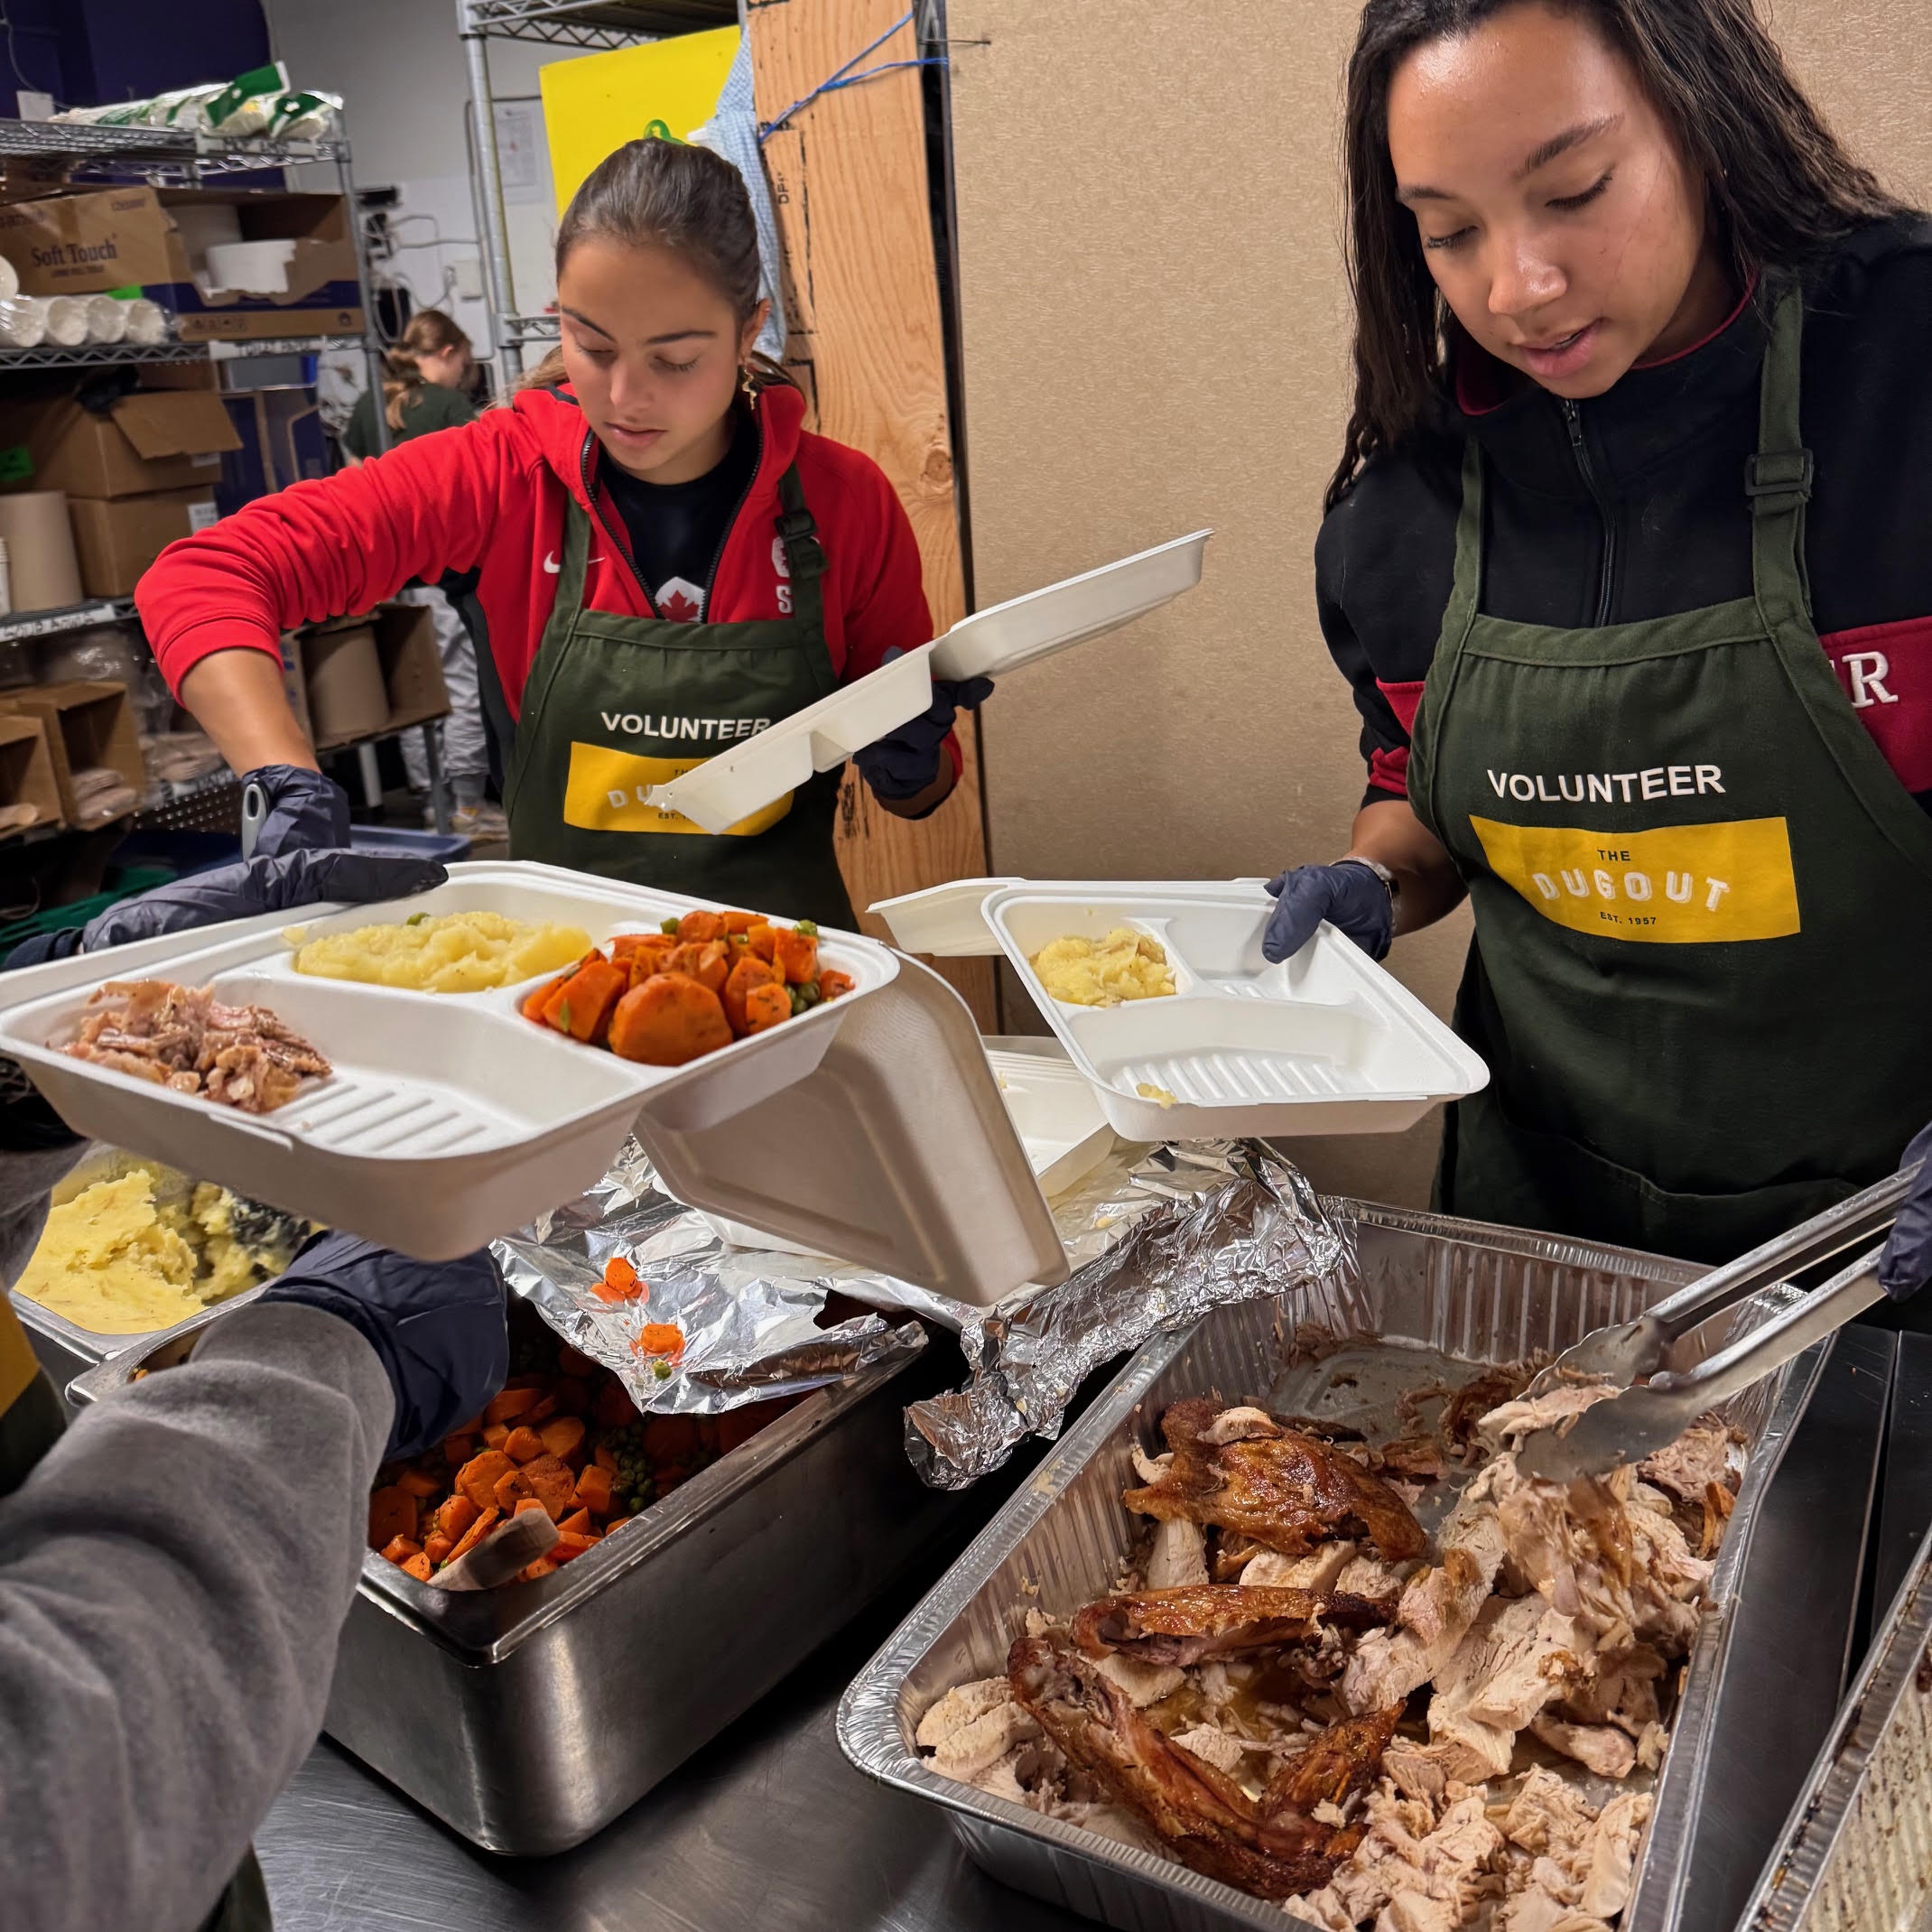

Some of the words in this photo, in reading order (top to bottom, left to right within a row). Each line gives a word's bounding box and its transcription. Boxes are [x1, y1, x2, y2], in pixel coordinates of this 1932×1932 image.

[31, 245, 66, 267] Soft
[68, 239, 117, 264] Touch
[775, 585, 794, 614] S
[1828, 651, 1899, 709] R
[600, 712, 771, 740] VOLUNTEER
[1487, 765, 1726, 803] VOLUNTEER
[1597, 850, 1631, 862] THE
[1532, 868, 1731, 912] DUGOUT
[1600, 911, 1623, 924] EST.
[1628, 916, 1658, 926] 1957
